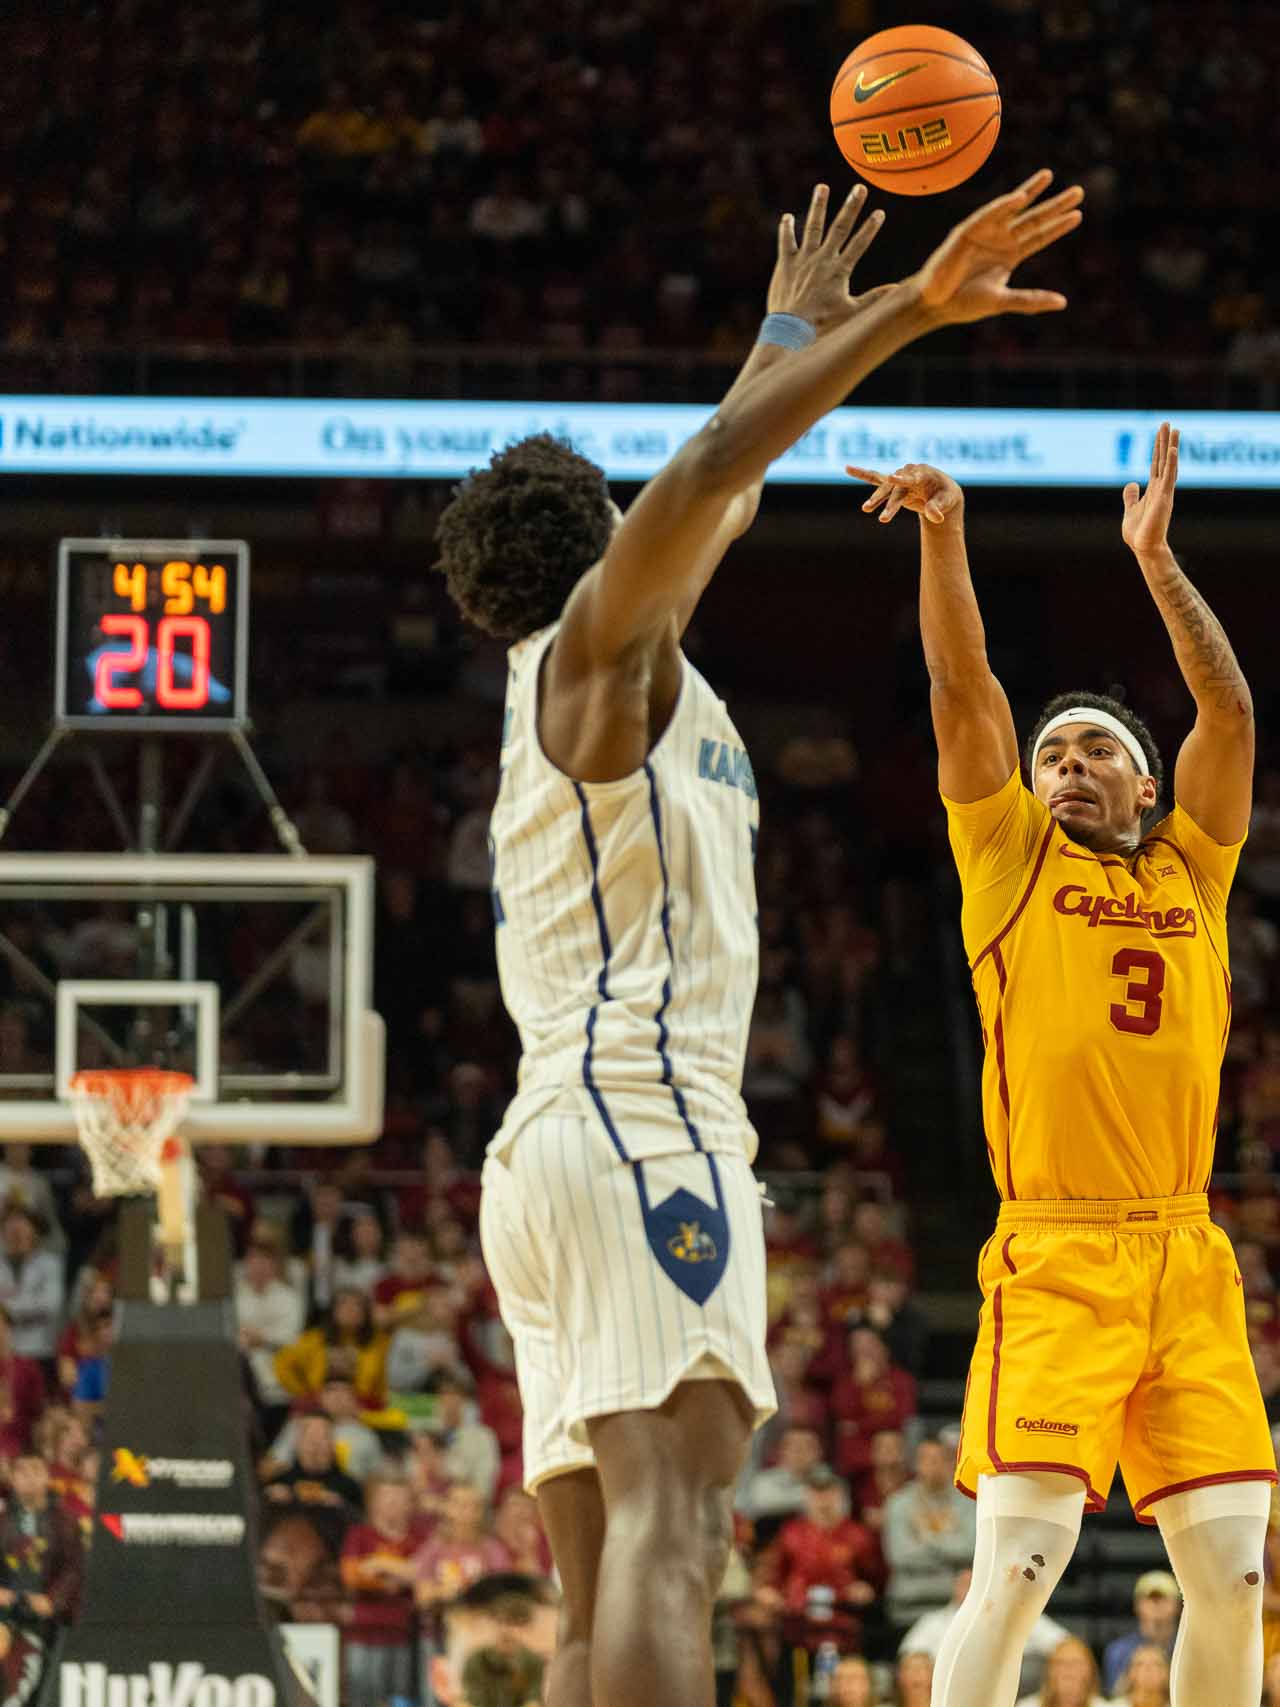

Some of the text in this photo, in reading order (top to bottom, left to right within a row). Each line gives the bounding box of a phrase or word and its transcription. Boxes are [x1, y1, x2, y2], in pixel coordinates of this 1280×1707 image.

[15, 415, 238, 450] Nationwide
[322, 415, 385, 452] On
[396, 425, 492, 473] your
[838, 423, 901, 460] the
[95, 614, 210, 709] 20
[1109, 946, 1166, 1038] 3
[1015, 1417, 1078, 1437] Cyclones
